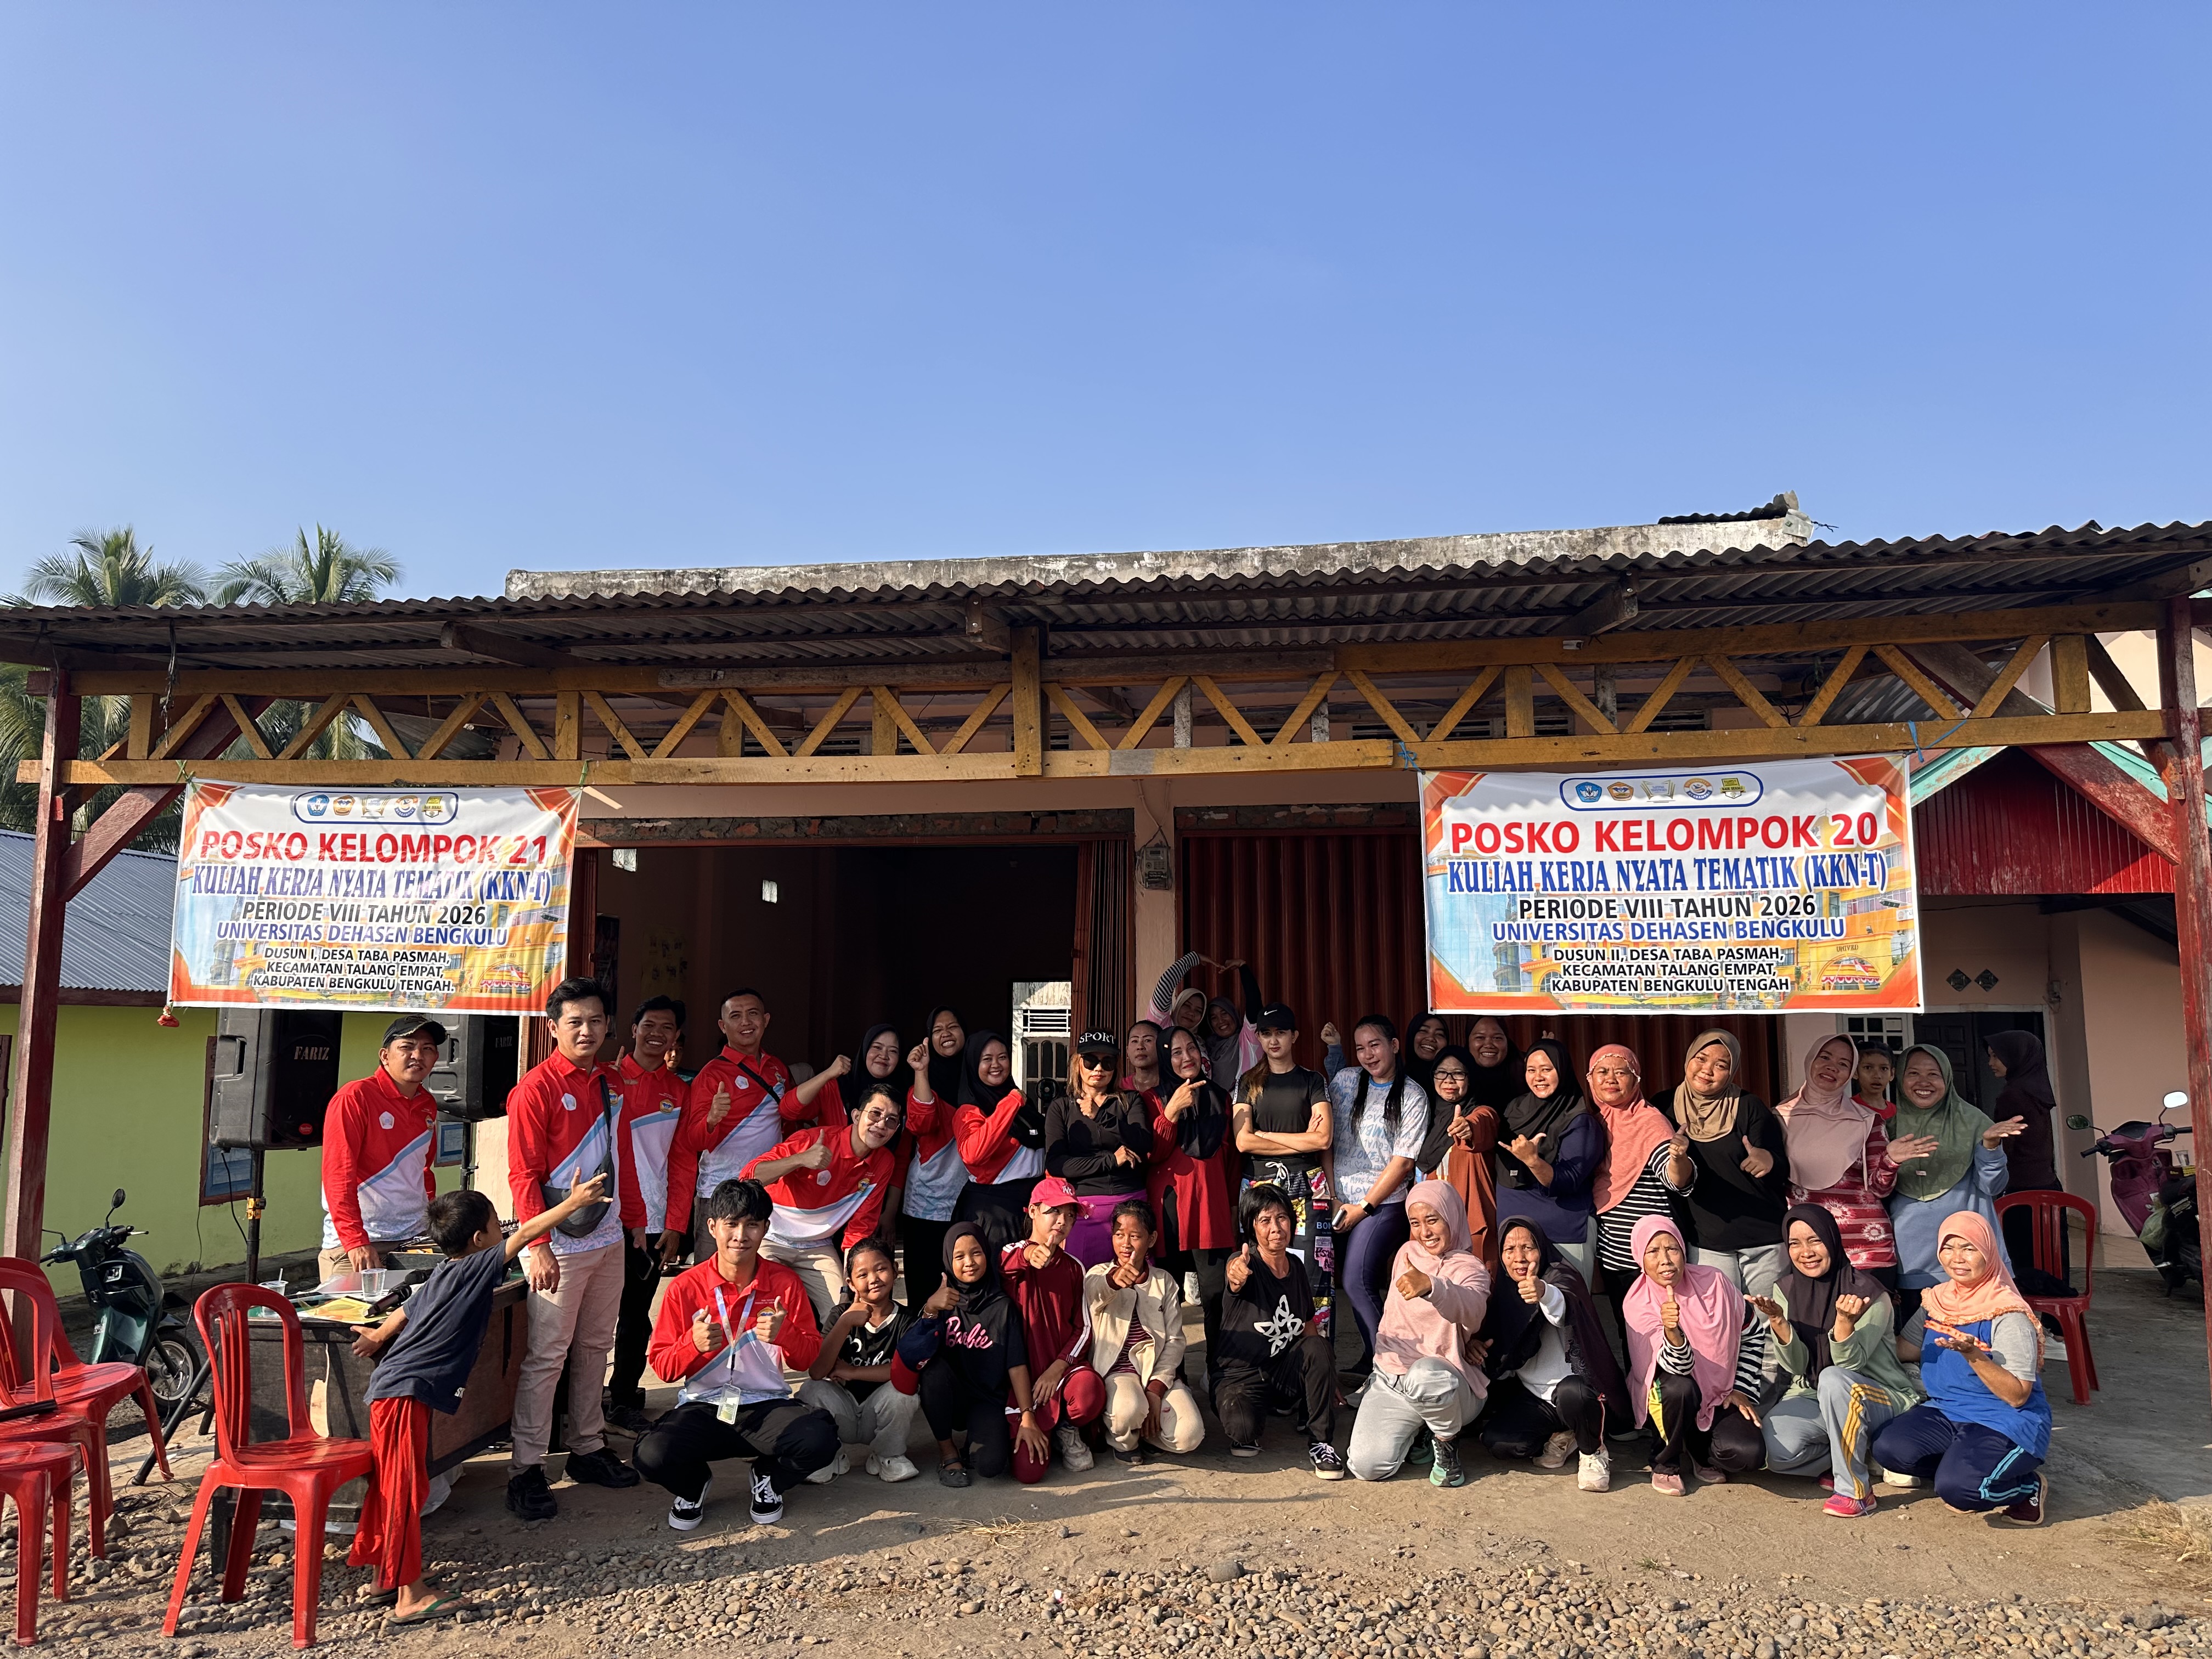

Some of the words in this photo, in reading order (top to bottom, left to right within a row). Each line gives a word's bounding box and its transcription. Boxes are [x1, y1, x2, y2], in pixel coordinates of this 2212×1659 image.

[1452, 821, 1579, 853] POSKO
[1595, 815, 1819, 853] KELOMPOK
[1832, 812, 1878, 845] 20
[200, 831, 307, 861] POSKO
[318, 832, 501, 864] KELOMPOK
[509, 836, 546, 864] 21
[1448, 861, 1534, 893] KULIAH
[1539, 860, 1611, 892] KERJA
[1616, 857, 1688, 892] NYATA
[1694, 856, 1798, 890] TEMATIK
[1804, 852, 1886, 893] (KKN-T)
[193, 865, 263, 894] KULIAH
[264, 867, 323, 896] KERJA
[328, 868, 385, 898] NYATA
[393, 870, 475, 899] TEMATIK
[480, 871, 550, 906] (KKN-T)
[242, 901, 323, 921] PERIODE
[330, 904, 360, 922] VIII
[368, 905, 432, 923] TAHUN
[437, 906, 486, 924] 2026
[1520, 899, 1617, 919] PERIODE
[1624, 899, 1662, 918] VIII
[1671, 896, 1752, 918] TAHUN
[1760, 894, 1815, 916] 2026
[217, 922, 323, 941] UNIVERSITAS
[329, 925, 408, 943] DEHASEN
[413, 928, 507, 945] BENGKULU
[1493, 922, 1623, 940] UNIVERSITAS
[1631, 921, 1727, 940] DEHASEN
[1735, 918, 1844, 939] BENGKULU
[264, 948, 306, 959] DUSUN
[311, 949, 317, 961] I,
[322, 949, 353, 960] DESA
[358, 950, 389, 961] TABA
[393, 951, 450, 964] PASMAH,
[1554, 949, 1605, 961] DUSUN
[1611, 949, 1624, 962] II,
[1630, 949, 1669, 960] DESA
[1674, 949, 1712, 960] TABA
[1717, 947, 1784, 961] PASMAH,
[267, 962, 342, 974] KECAMATAN
[347, 964, 395, 976] TALANG
[400, 966, 443, 978] EMPAT,
[1563, 964, 1655, 976] KECAMATAN
[1661, 964, 1719, 976] TALANG
[1724, 963, 1776, 977] EMPAT,
[253, 975, 325, 987] KABUPATEN
[329, 978, 395, 990] BENGKULU
[399, 979, 454, 991] TENGAH.
[1552, 980, 1638, 991] KABUPATEN
[1644, 979, 1723, 991] BENGKULU
[1728, 978, 1789, 991] TENGAH
[495, 1036, 512, 1048] FARIZ
[1079, 1032, 1114, 1044] SPORT
[294, 1046, 329, 1060] FARIZ
[1351, 1185, 1371, 1195] LOV
[946, 1316, 993, 1349] Barbie
